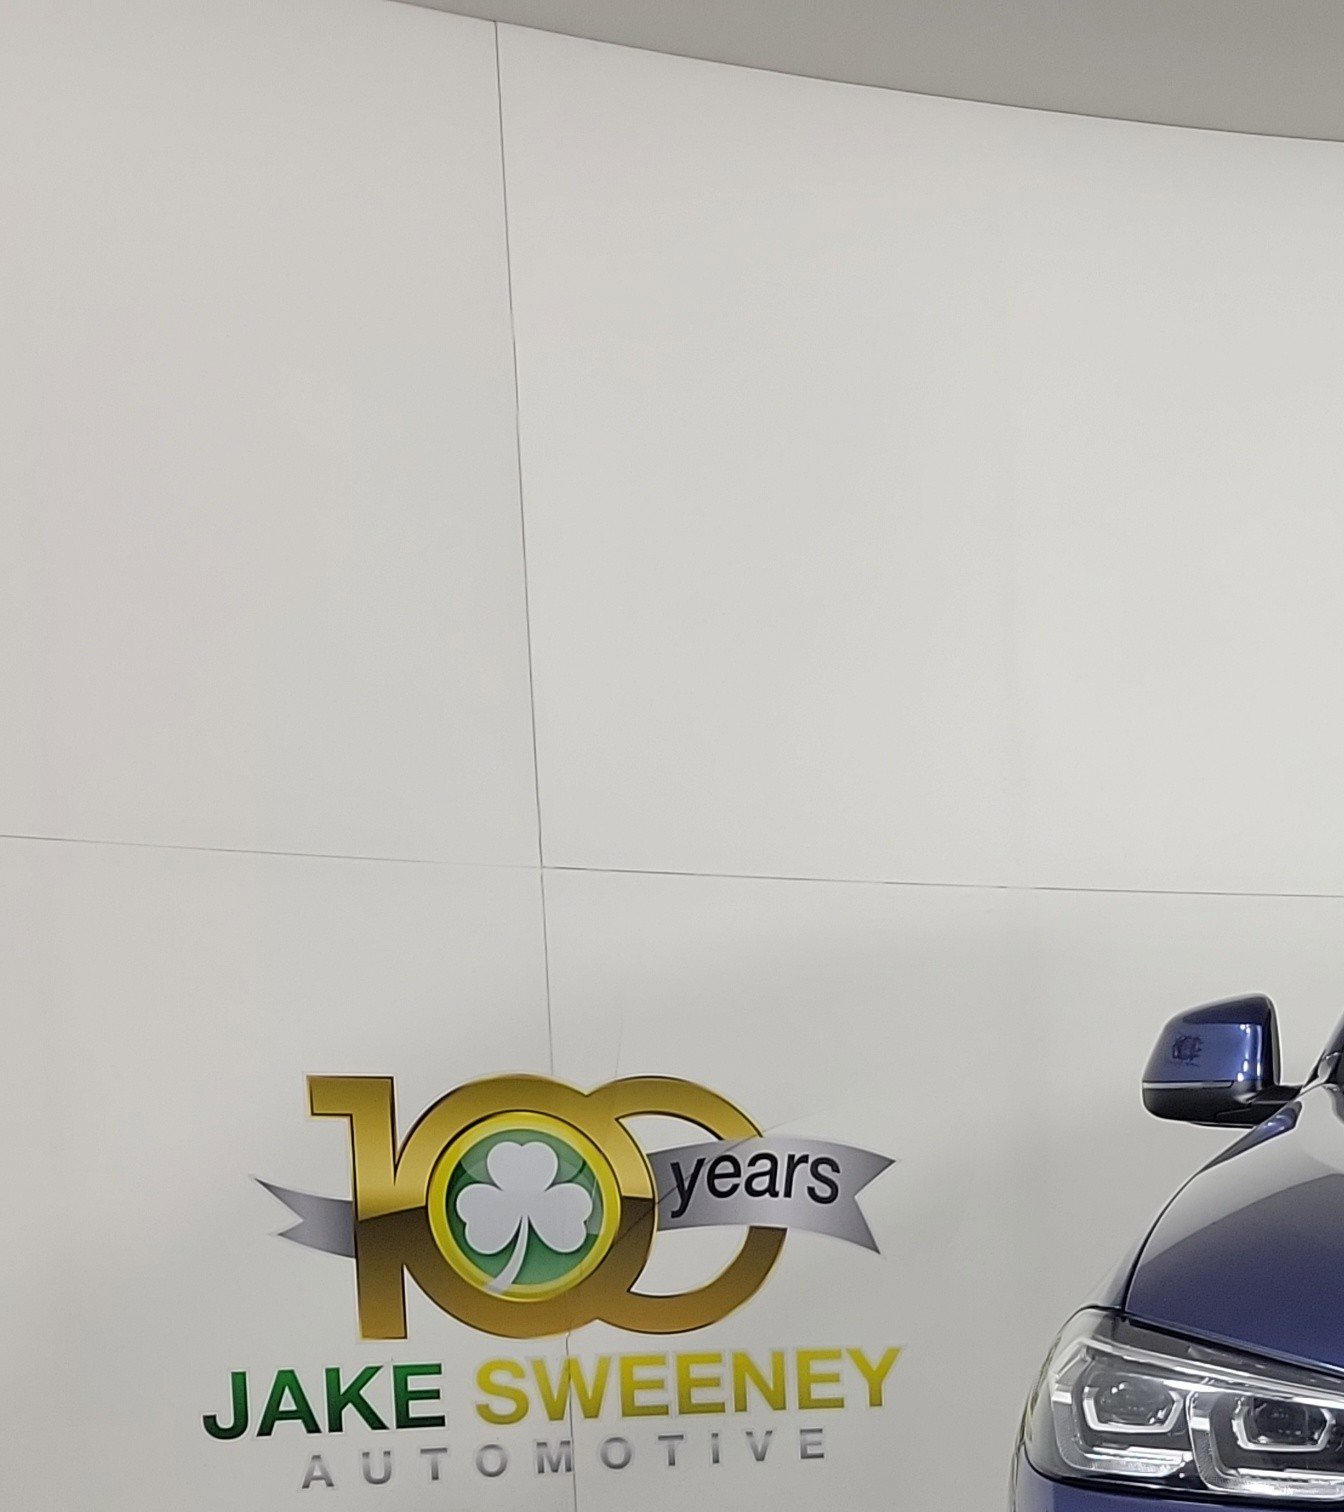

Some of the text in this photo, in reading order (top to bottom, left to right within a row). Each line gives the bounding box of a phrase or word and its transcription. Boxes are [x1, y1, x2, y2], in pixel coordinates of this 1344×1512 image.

[306, 1072, 842, 1339] 100 years
[202, 1347, 902, 1440] JAKE SWEENEY
[301, 1429, 825, 1489] AUTOMOTIVE
